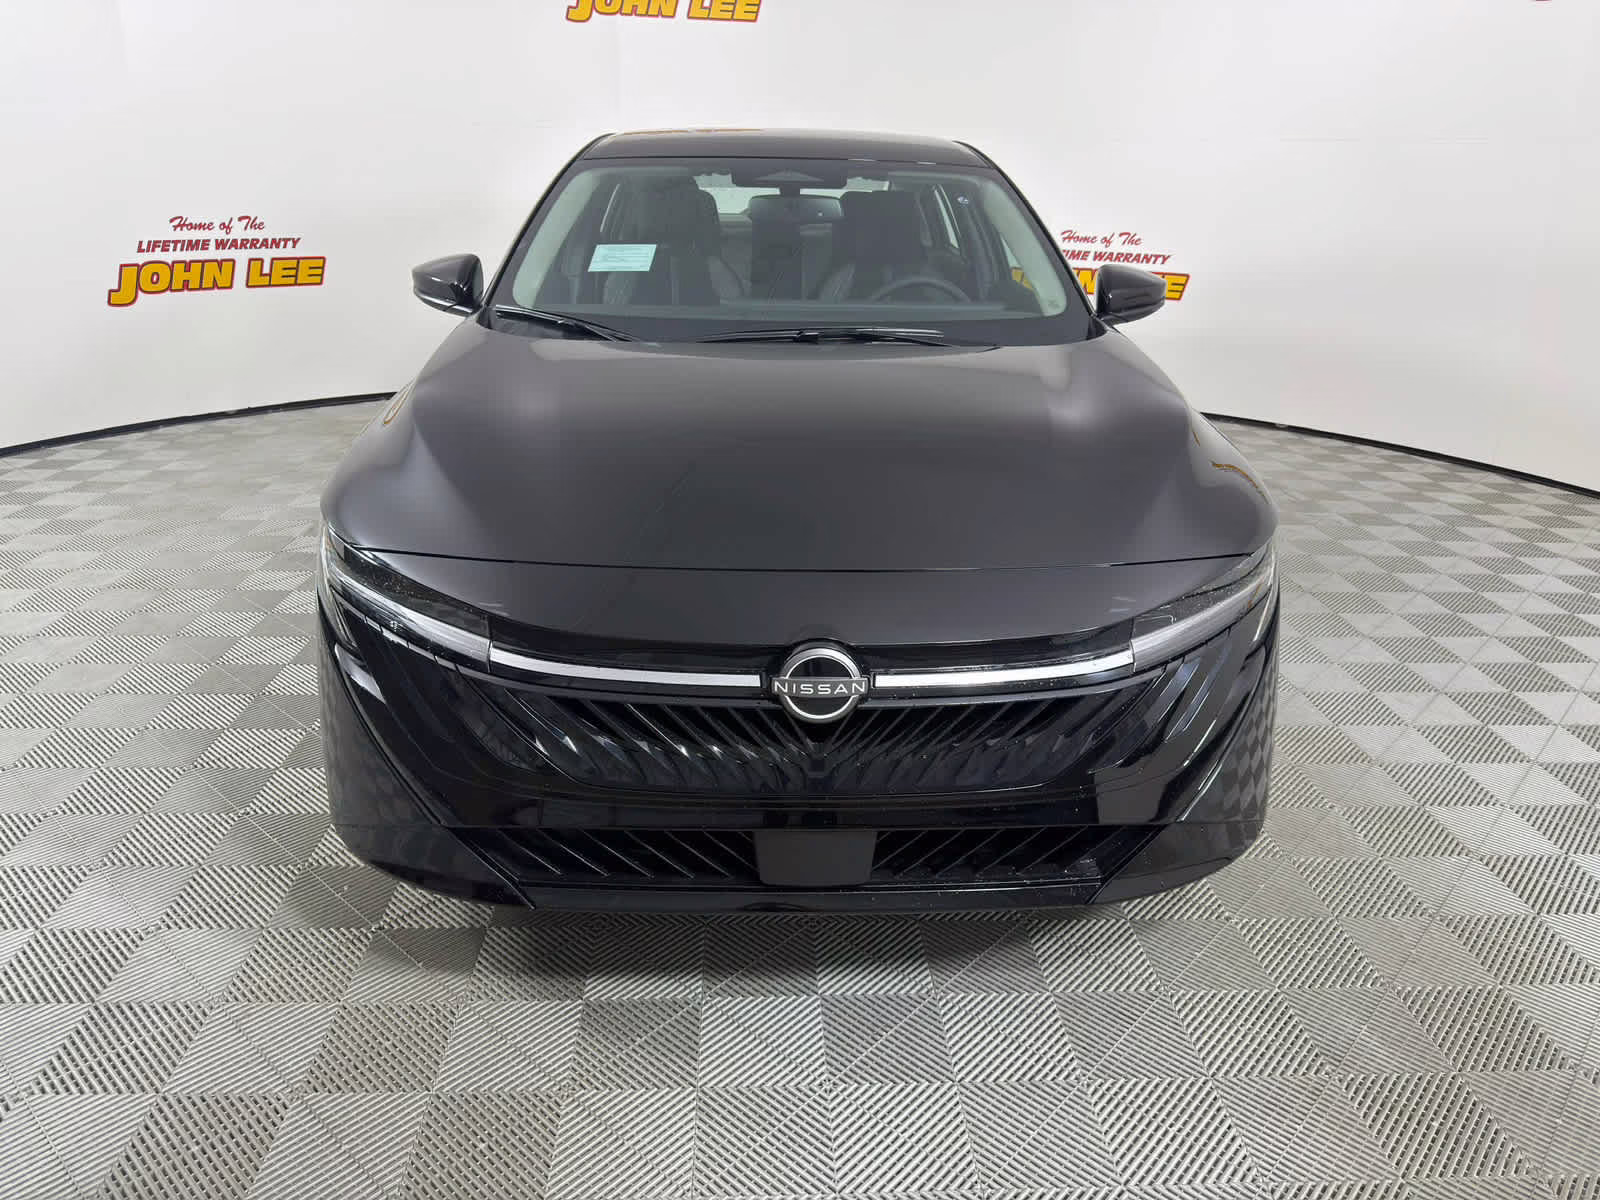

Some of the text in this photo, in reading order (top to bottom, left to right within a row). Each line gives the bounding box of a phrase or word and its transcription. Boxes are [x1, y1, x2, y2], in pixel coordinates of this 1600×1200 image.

[565, 0, 762, 23] JOHN LEE
[168, 215, 265, 235] Home of The
[136, 237, 301, 253] LIFETIME WARRANTY
[1060, 229, 1143, 248] Home of The
[1092, 251, 1171, 265] WARRANTY
[107, 256, 326, 307] JOHN LEE
[774, 681, 865, 695] NISSAN
